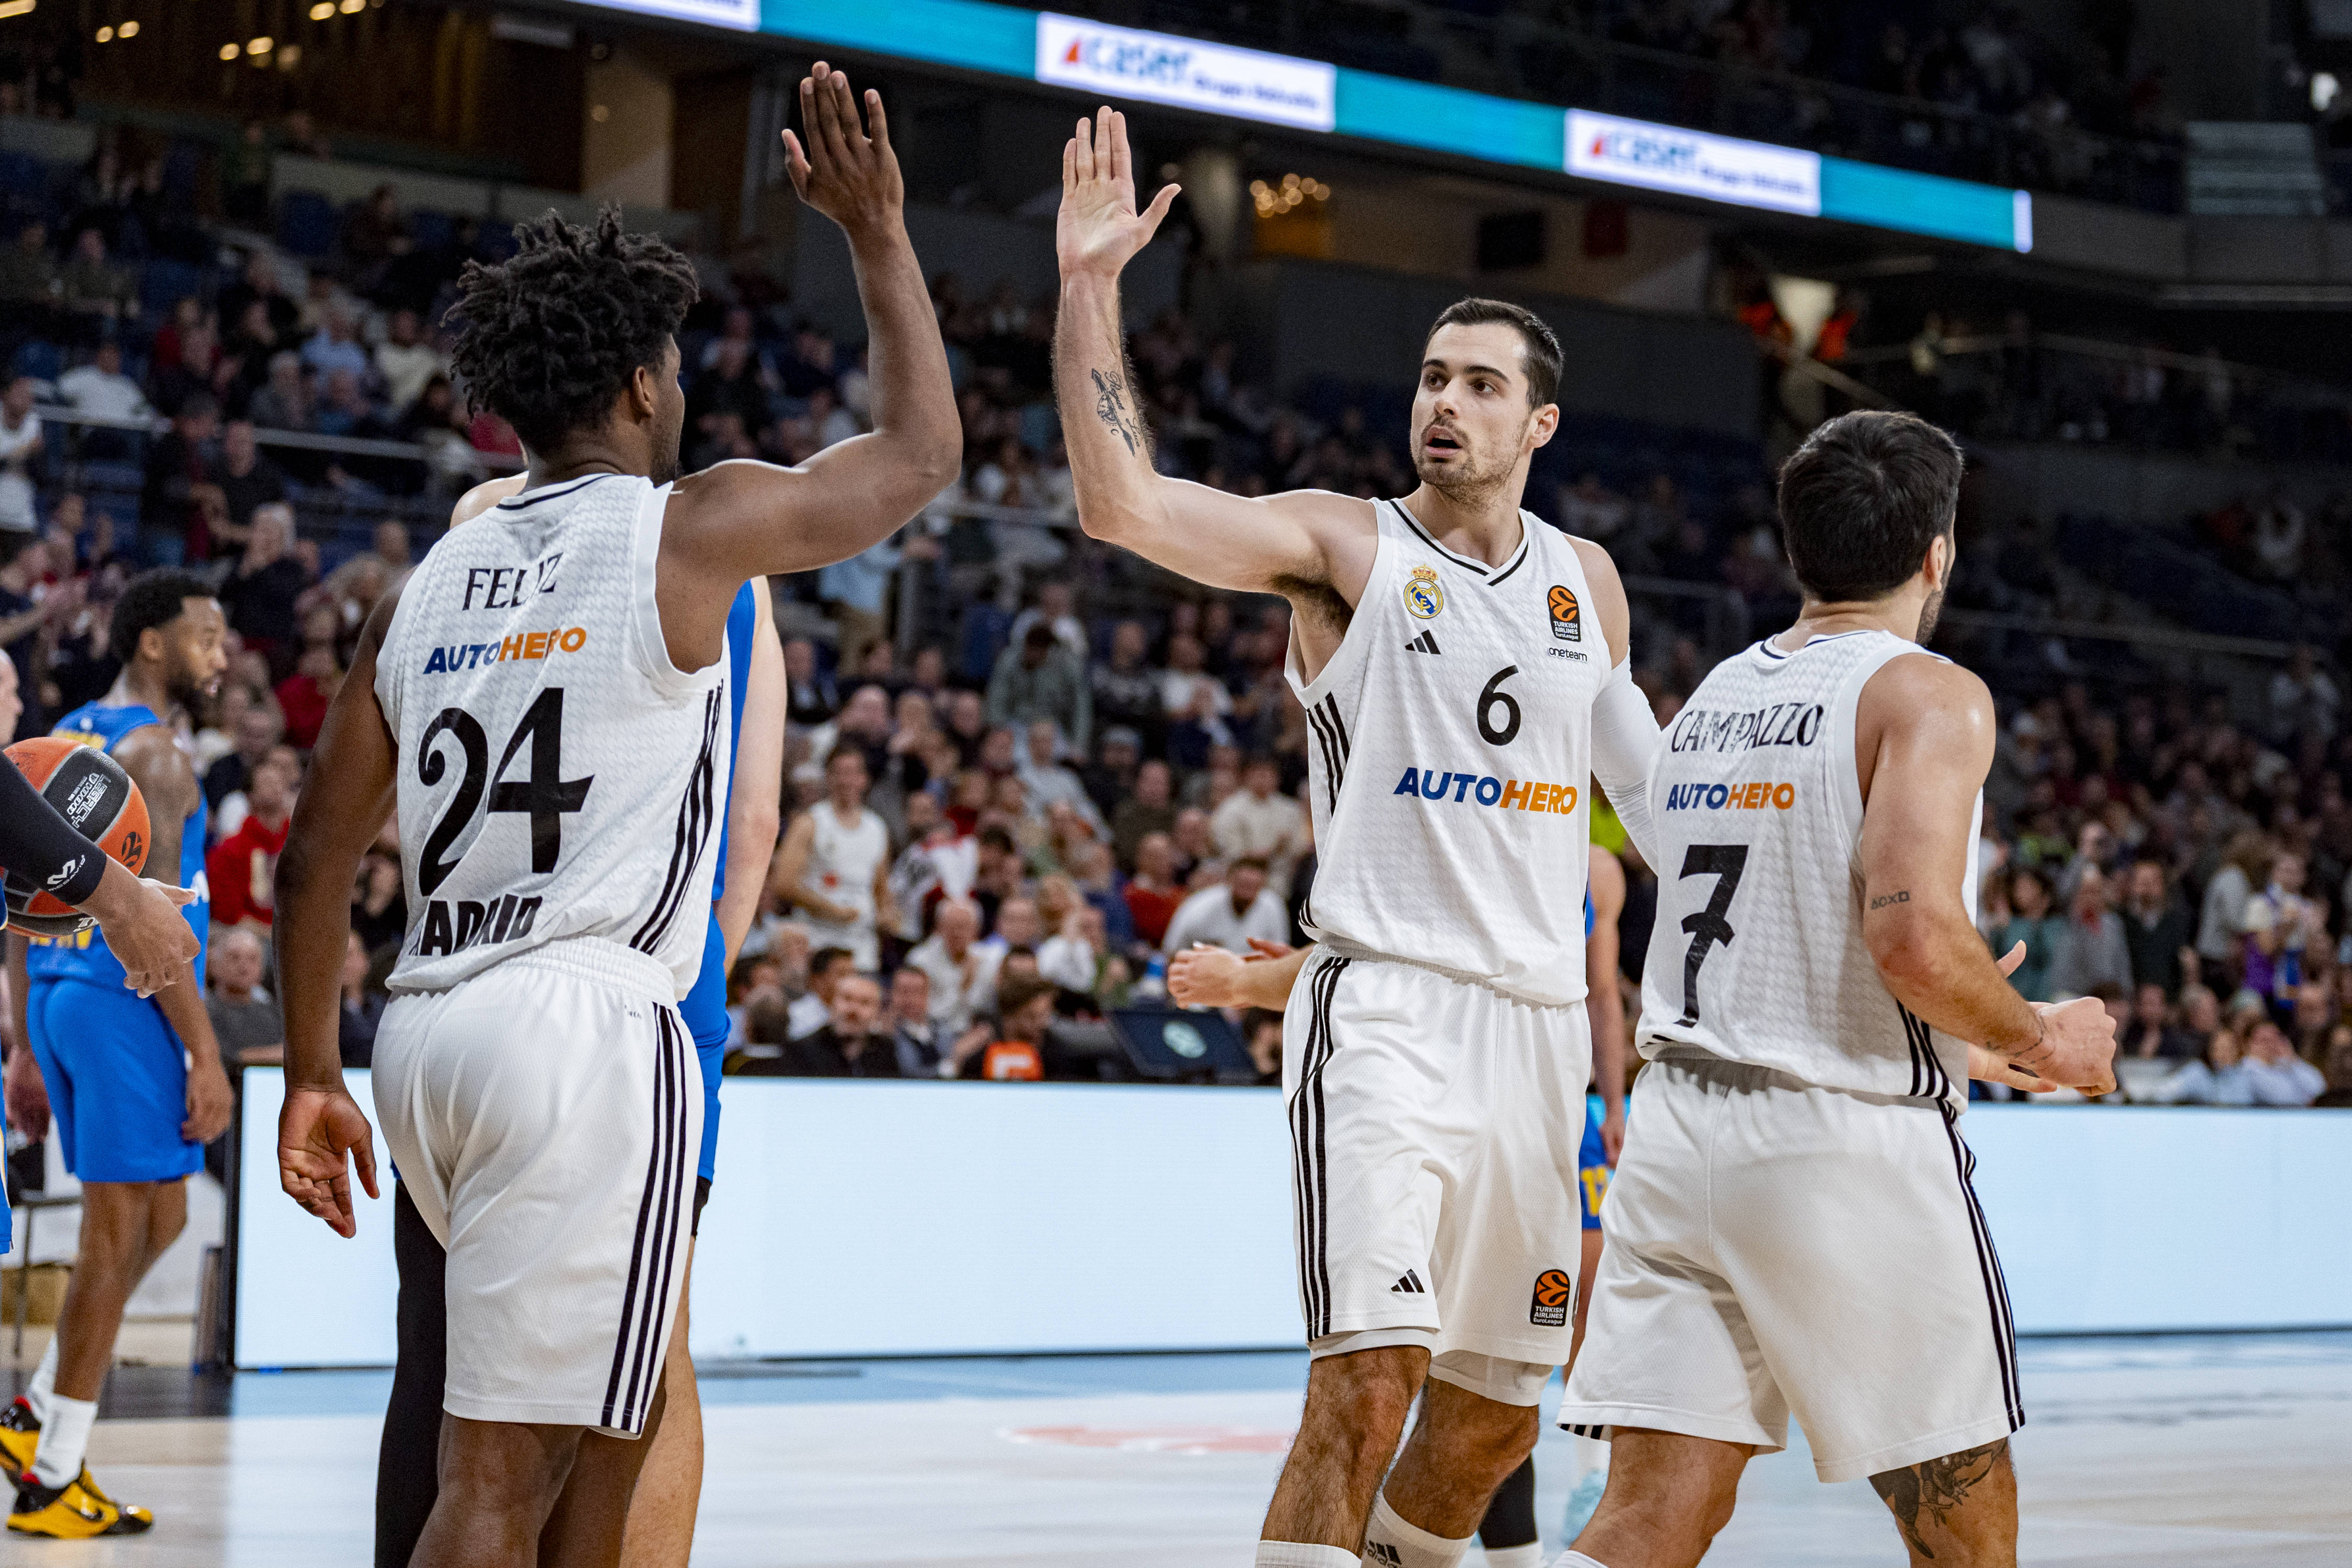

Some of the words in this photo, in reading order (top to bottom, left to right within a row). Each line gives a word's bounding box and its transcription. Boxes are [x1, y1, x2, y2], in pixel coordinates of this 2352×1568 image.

[462, 551, 564, 611] FELIZ
[1553, 620, 1578, 629] TURKISH
[1555, 627, 1578, 635] AIRLINES
[1555, 632, 1579, 640] EuroLeague
[423, 627, 586, 674] AUTOHERO
[1549, 647, 1587, 662] oneteam
[1477, 664, 1521, 746] 6
[1671, 702, 1824, 753] CAMPAZZO
[72, 774, 111, 828] LEGACY
[418, 687, 595, 897] 24
[1393, 766, 1577, 815] AUTOHERO
[1666, 782, 1795, 811] AUTOHERO
[408, 893, 543, 956] ADRID
[1673, 844, 1749, 1029] 7
